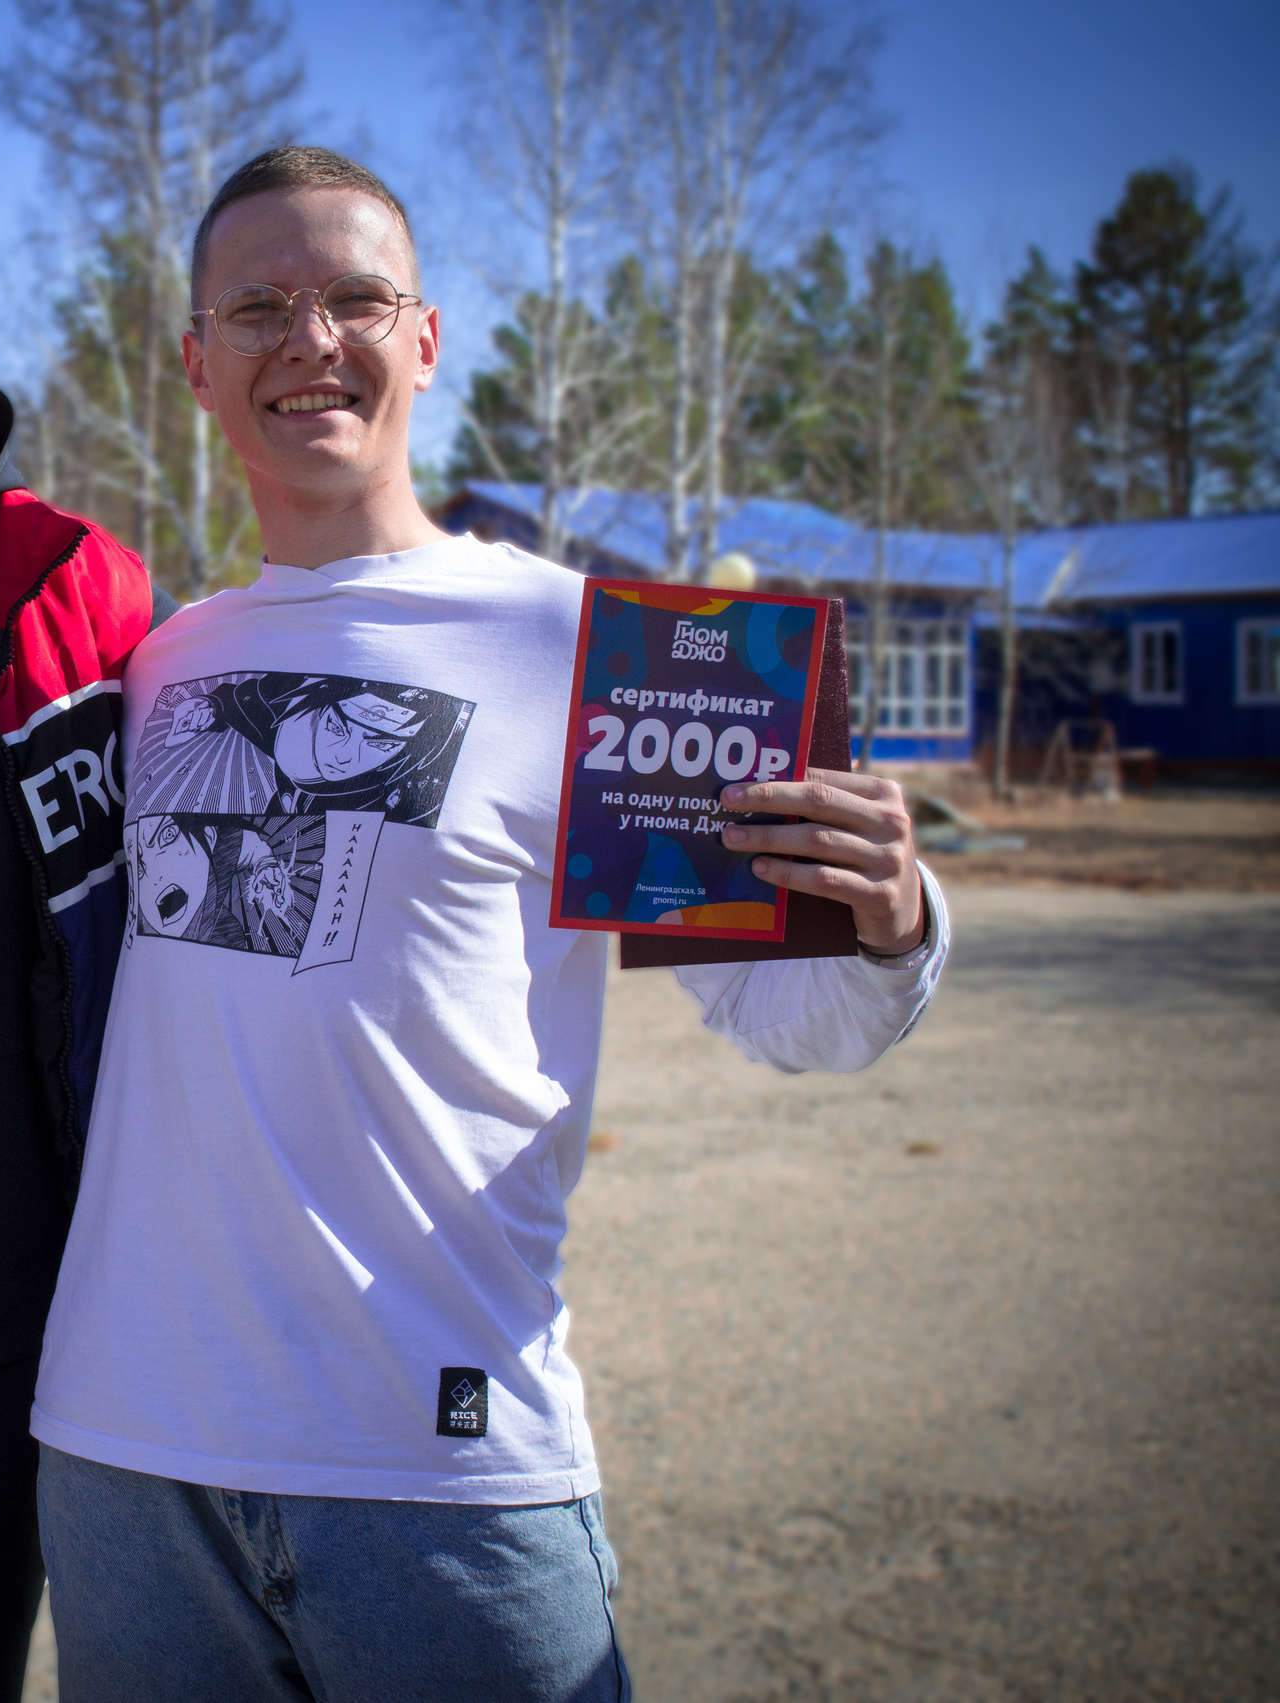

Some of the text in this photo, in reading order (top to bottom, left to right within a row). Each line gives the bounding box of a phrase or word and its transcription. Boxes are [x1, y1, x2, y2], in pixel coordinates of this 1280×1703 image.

[610, 687, 774, 717] сертификат
[601, 791, 623, 804] на
[628, 793, 674, 811] одну
[619, 813, 631, 830] у
[634, 814, 689, 831] гнома
[635, 883, 706, 895] Ленинградская, 58
[652, 897, 687, 905] gnomj.ru
[450, 1411, 478, 1420] RICE
